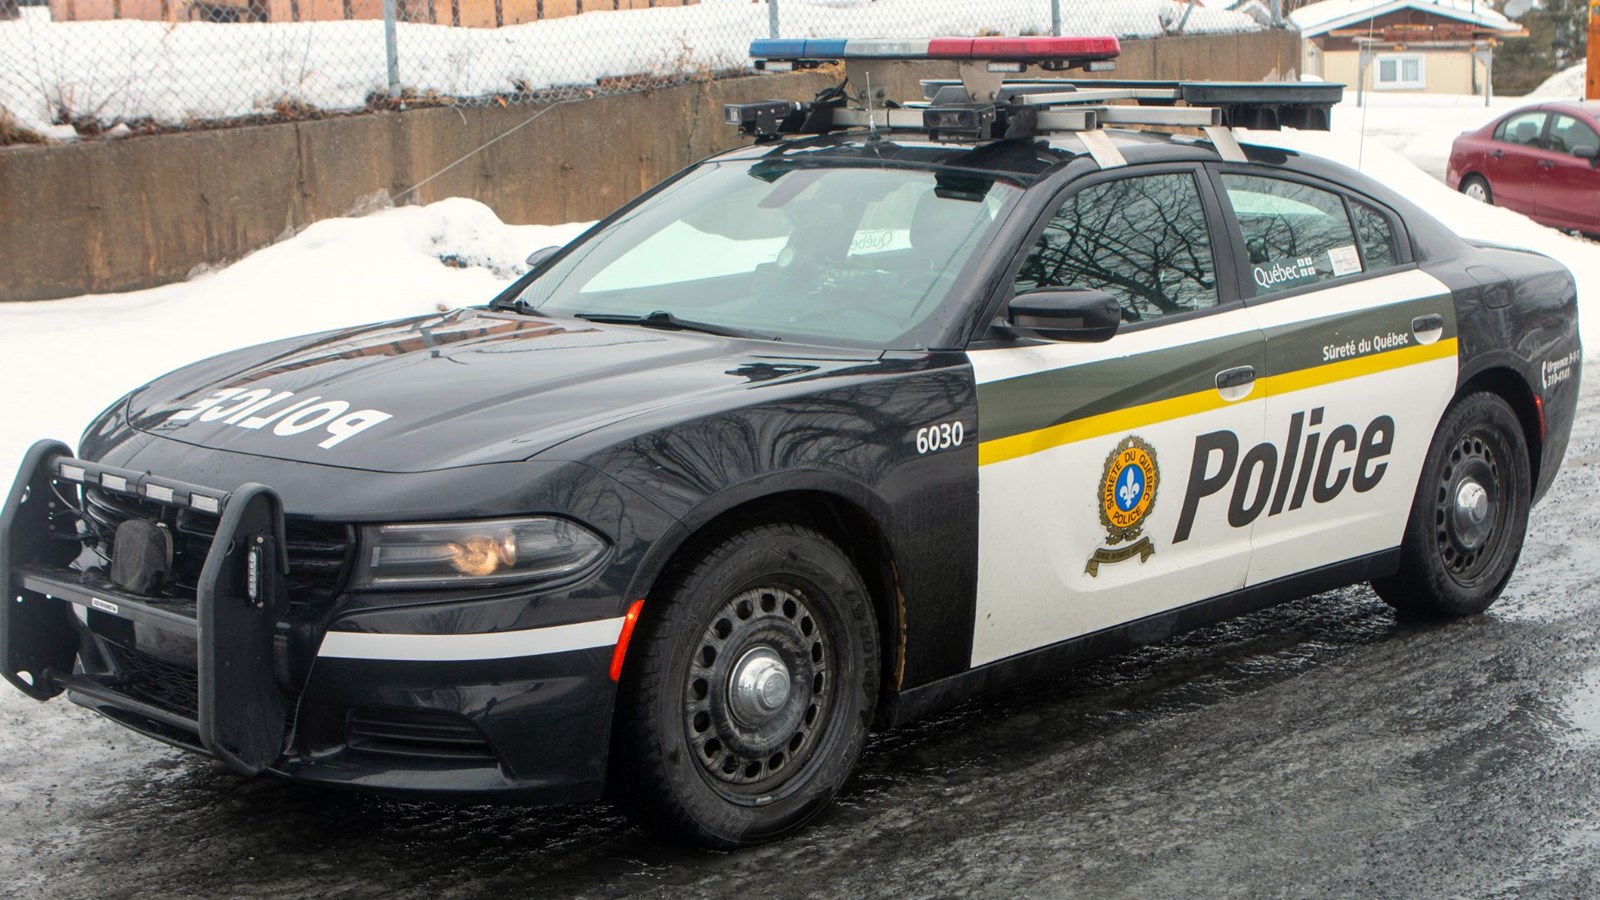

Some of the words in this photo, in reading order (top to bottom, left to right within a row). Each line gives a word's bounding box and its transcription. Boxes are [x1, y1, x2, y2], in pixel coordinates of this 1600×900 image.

[1254, 263, 1300, 288] Québec
[1323, 340, 1356, 361] Sûreté
[1358, 339, 1371, 353] du
[1373, 333, 1408, 351] Québec
[917, 421, 963, 454] 6030
[1124, 450, 1136, 462] DU
[1172, 406, 1395, 544] Police
[1112, 505, 1142, 525] POLICE
